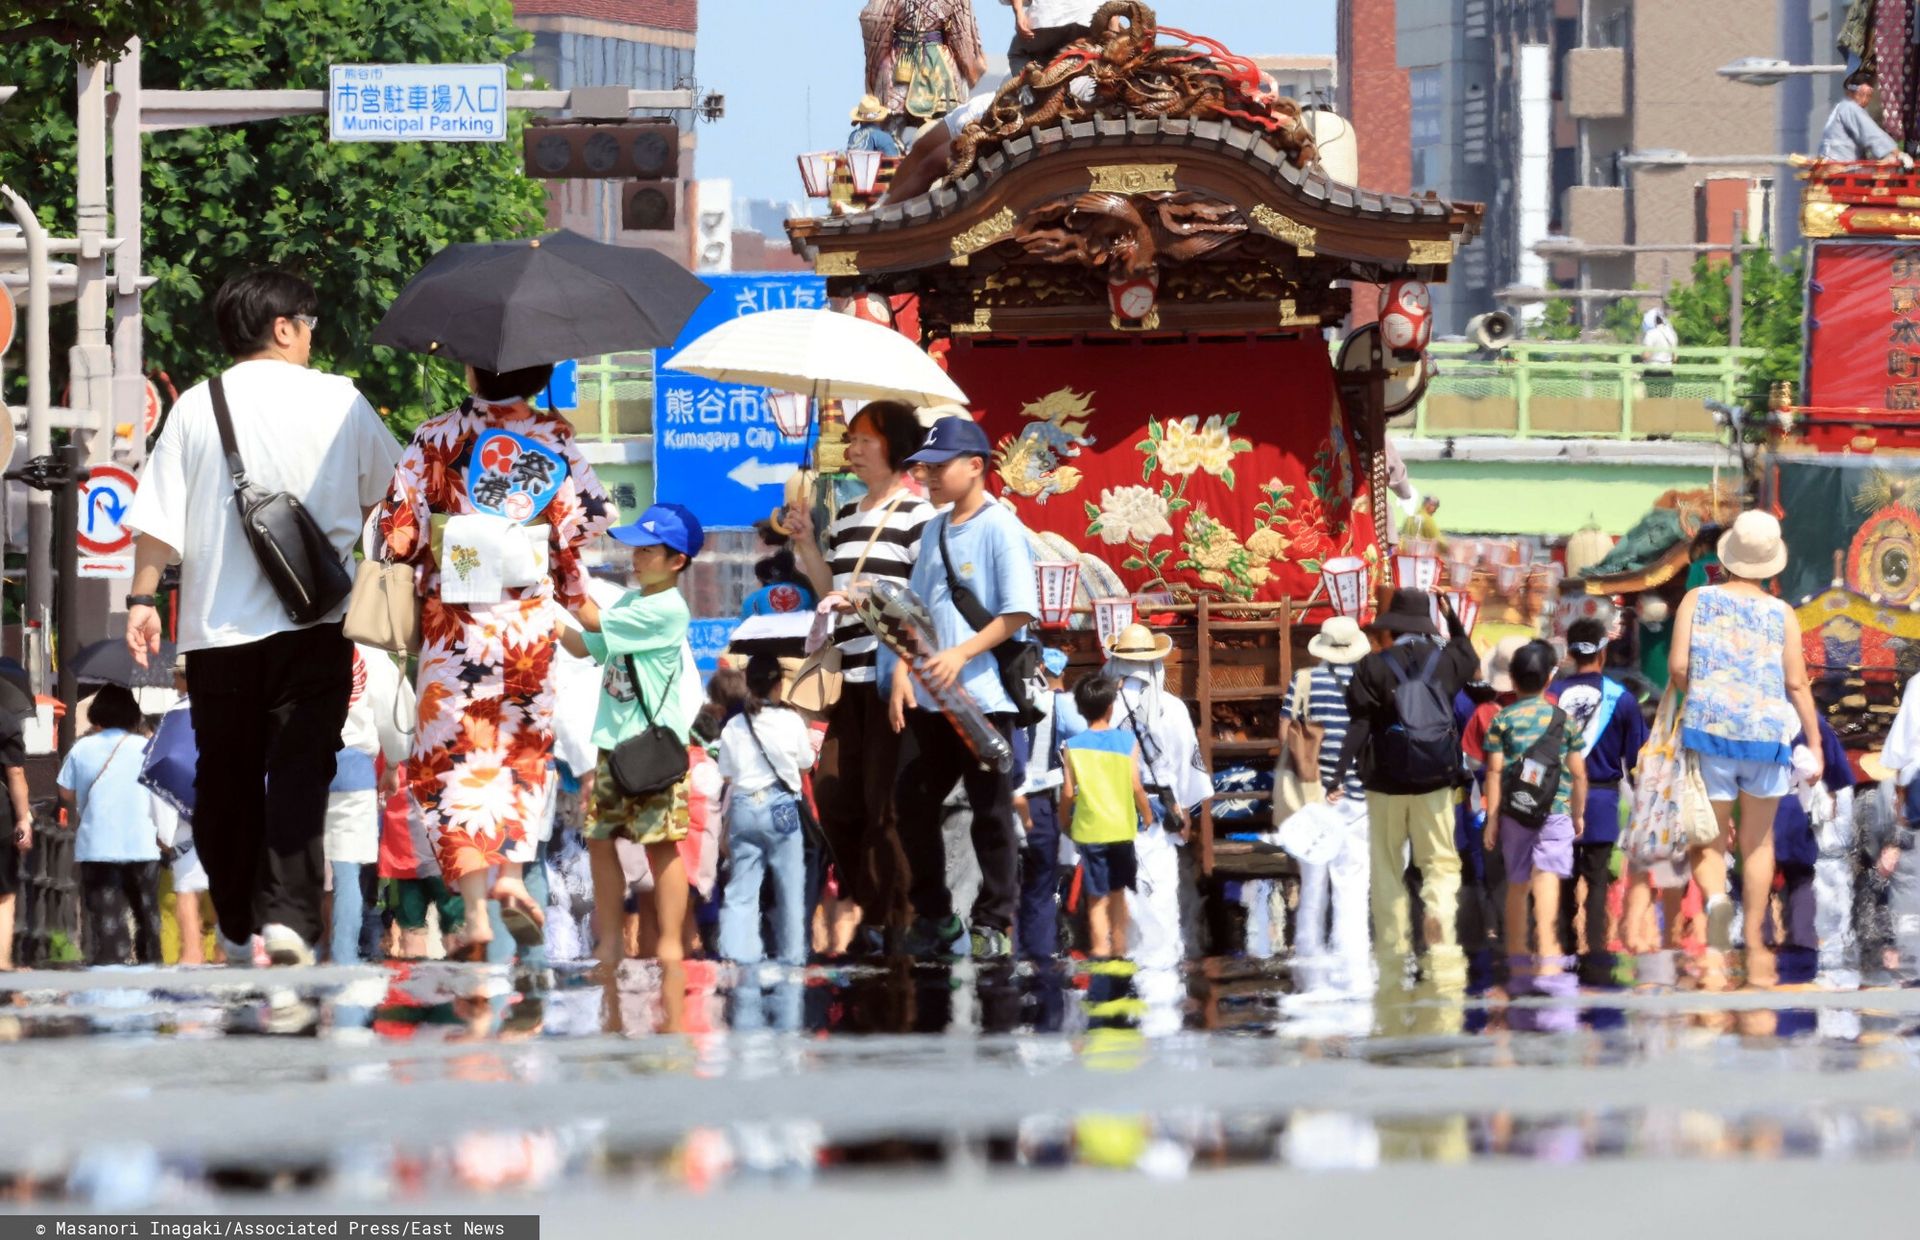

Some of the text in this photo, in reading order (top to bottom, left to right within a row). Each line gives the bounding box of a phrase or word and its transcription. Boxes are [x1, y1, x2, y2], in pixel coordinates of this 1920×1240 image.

[344, 68, 383, 80] 熊谷市
[337, 83, 498, 113] 市営駐車場入口
[342, 115, 494, 135] Municipal Parking
[735, 285, 830, 317] さいた
[664, 429, 740, 452] Kumagaya
[745, 427, 776, 451] City
